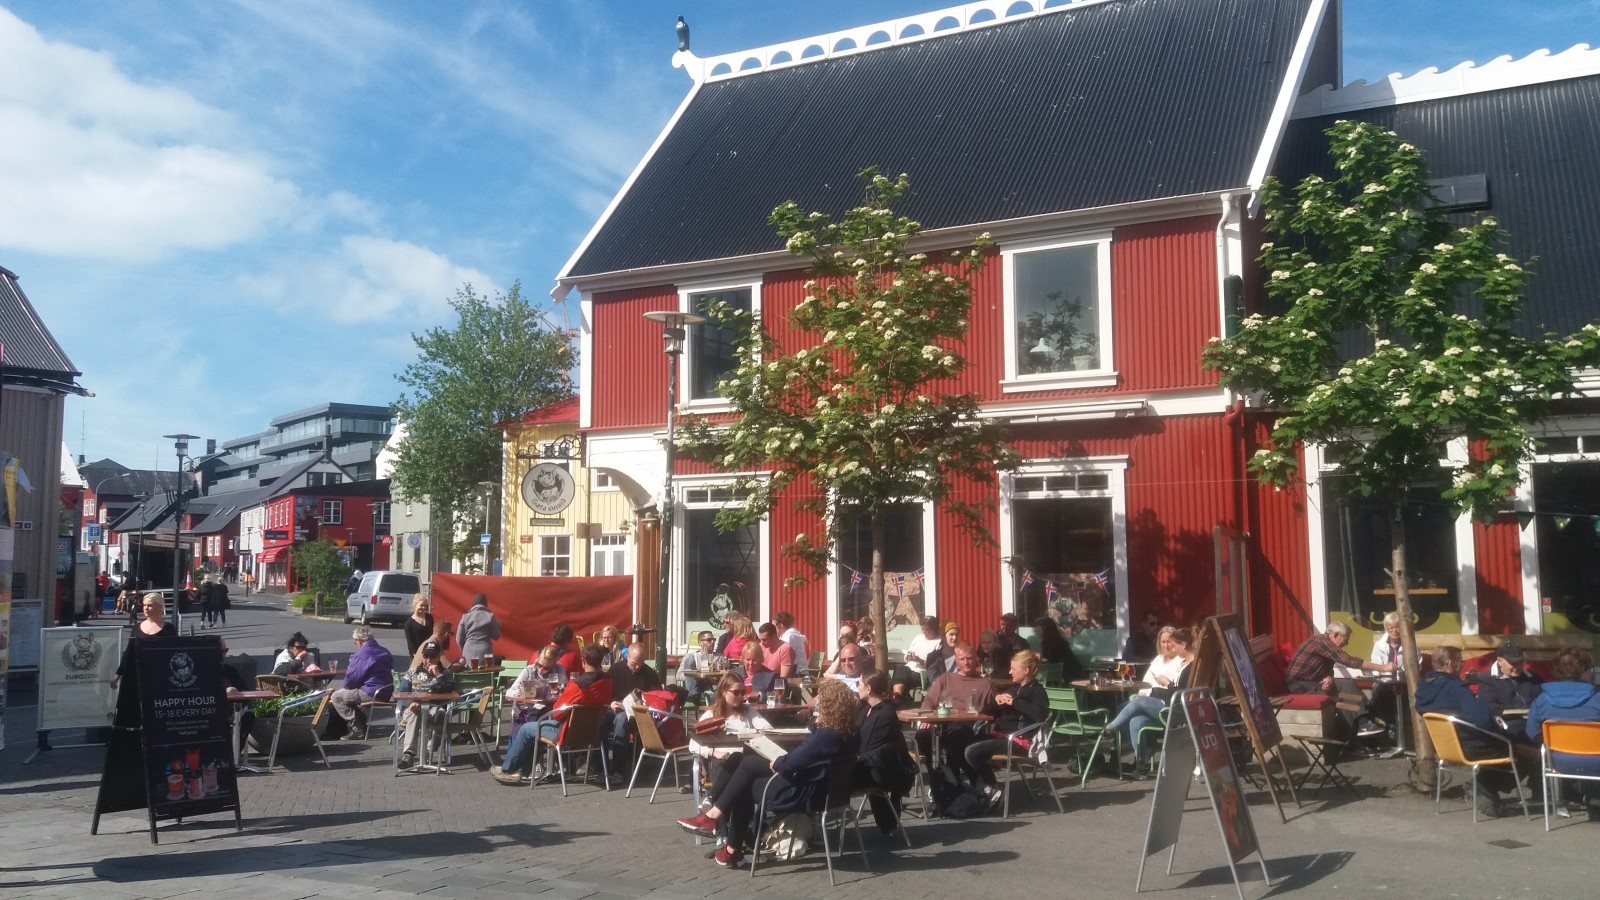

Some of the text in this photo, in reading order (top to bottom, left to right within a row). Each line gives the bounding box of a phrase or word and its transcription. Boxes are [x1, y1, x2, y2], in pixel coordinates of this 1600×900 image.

[154, 696, 216, 708] HAPPY HOUR
[176, 708, 200, 718] EVERY
[201, 707, 217, 716] DAY
